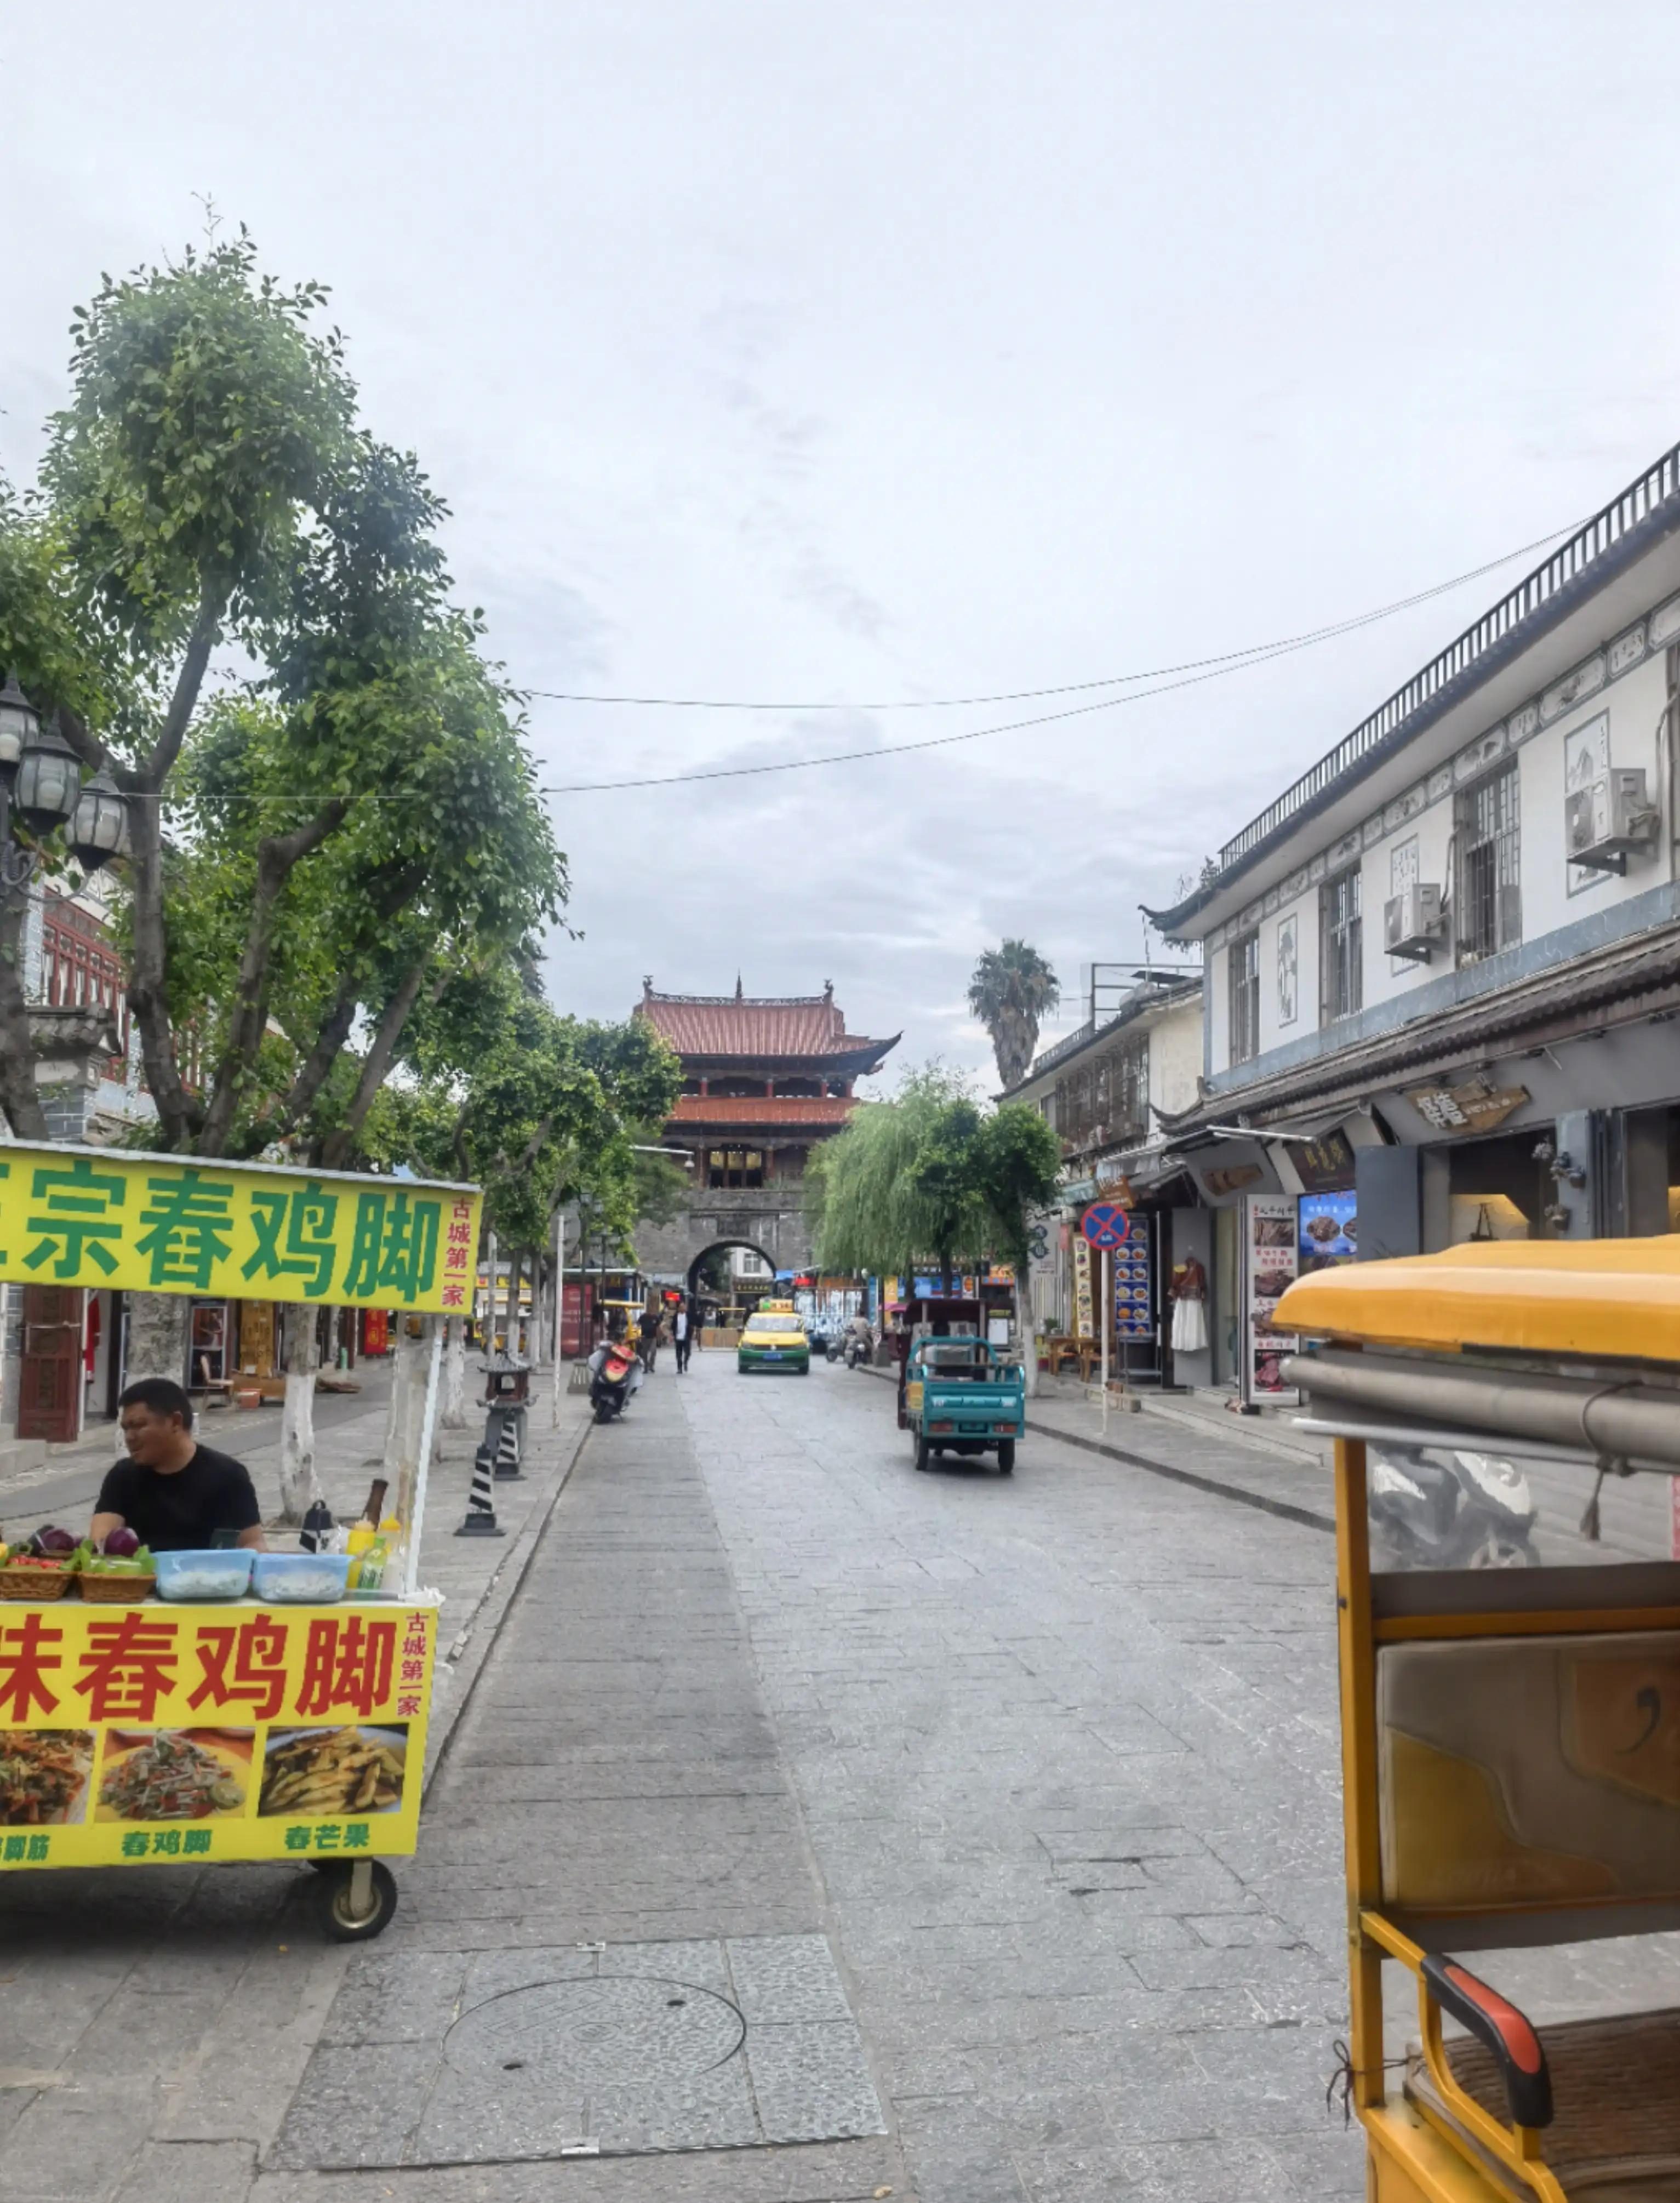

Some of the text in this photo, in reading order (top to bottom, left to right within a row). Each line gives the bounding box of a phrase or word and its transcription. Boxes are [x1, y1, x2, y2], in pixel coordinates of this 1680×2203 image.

[0, 1160, 441, 1303] 宗舂鸡脚
[442, 1197, 475, 1306] 古城第一家
[397, 1612, 429, 1716] 古城第一家
[0, 1835, 50, 1861] 脚筋
